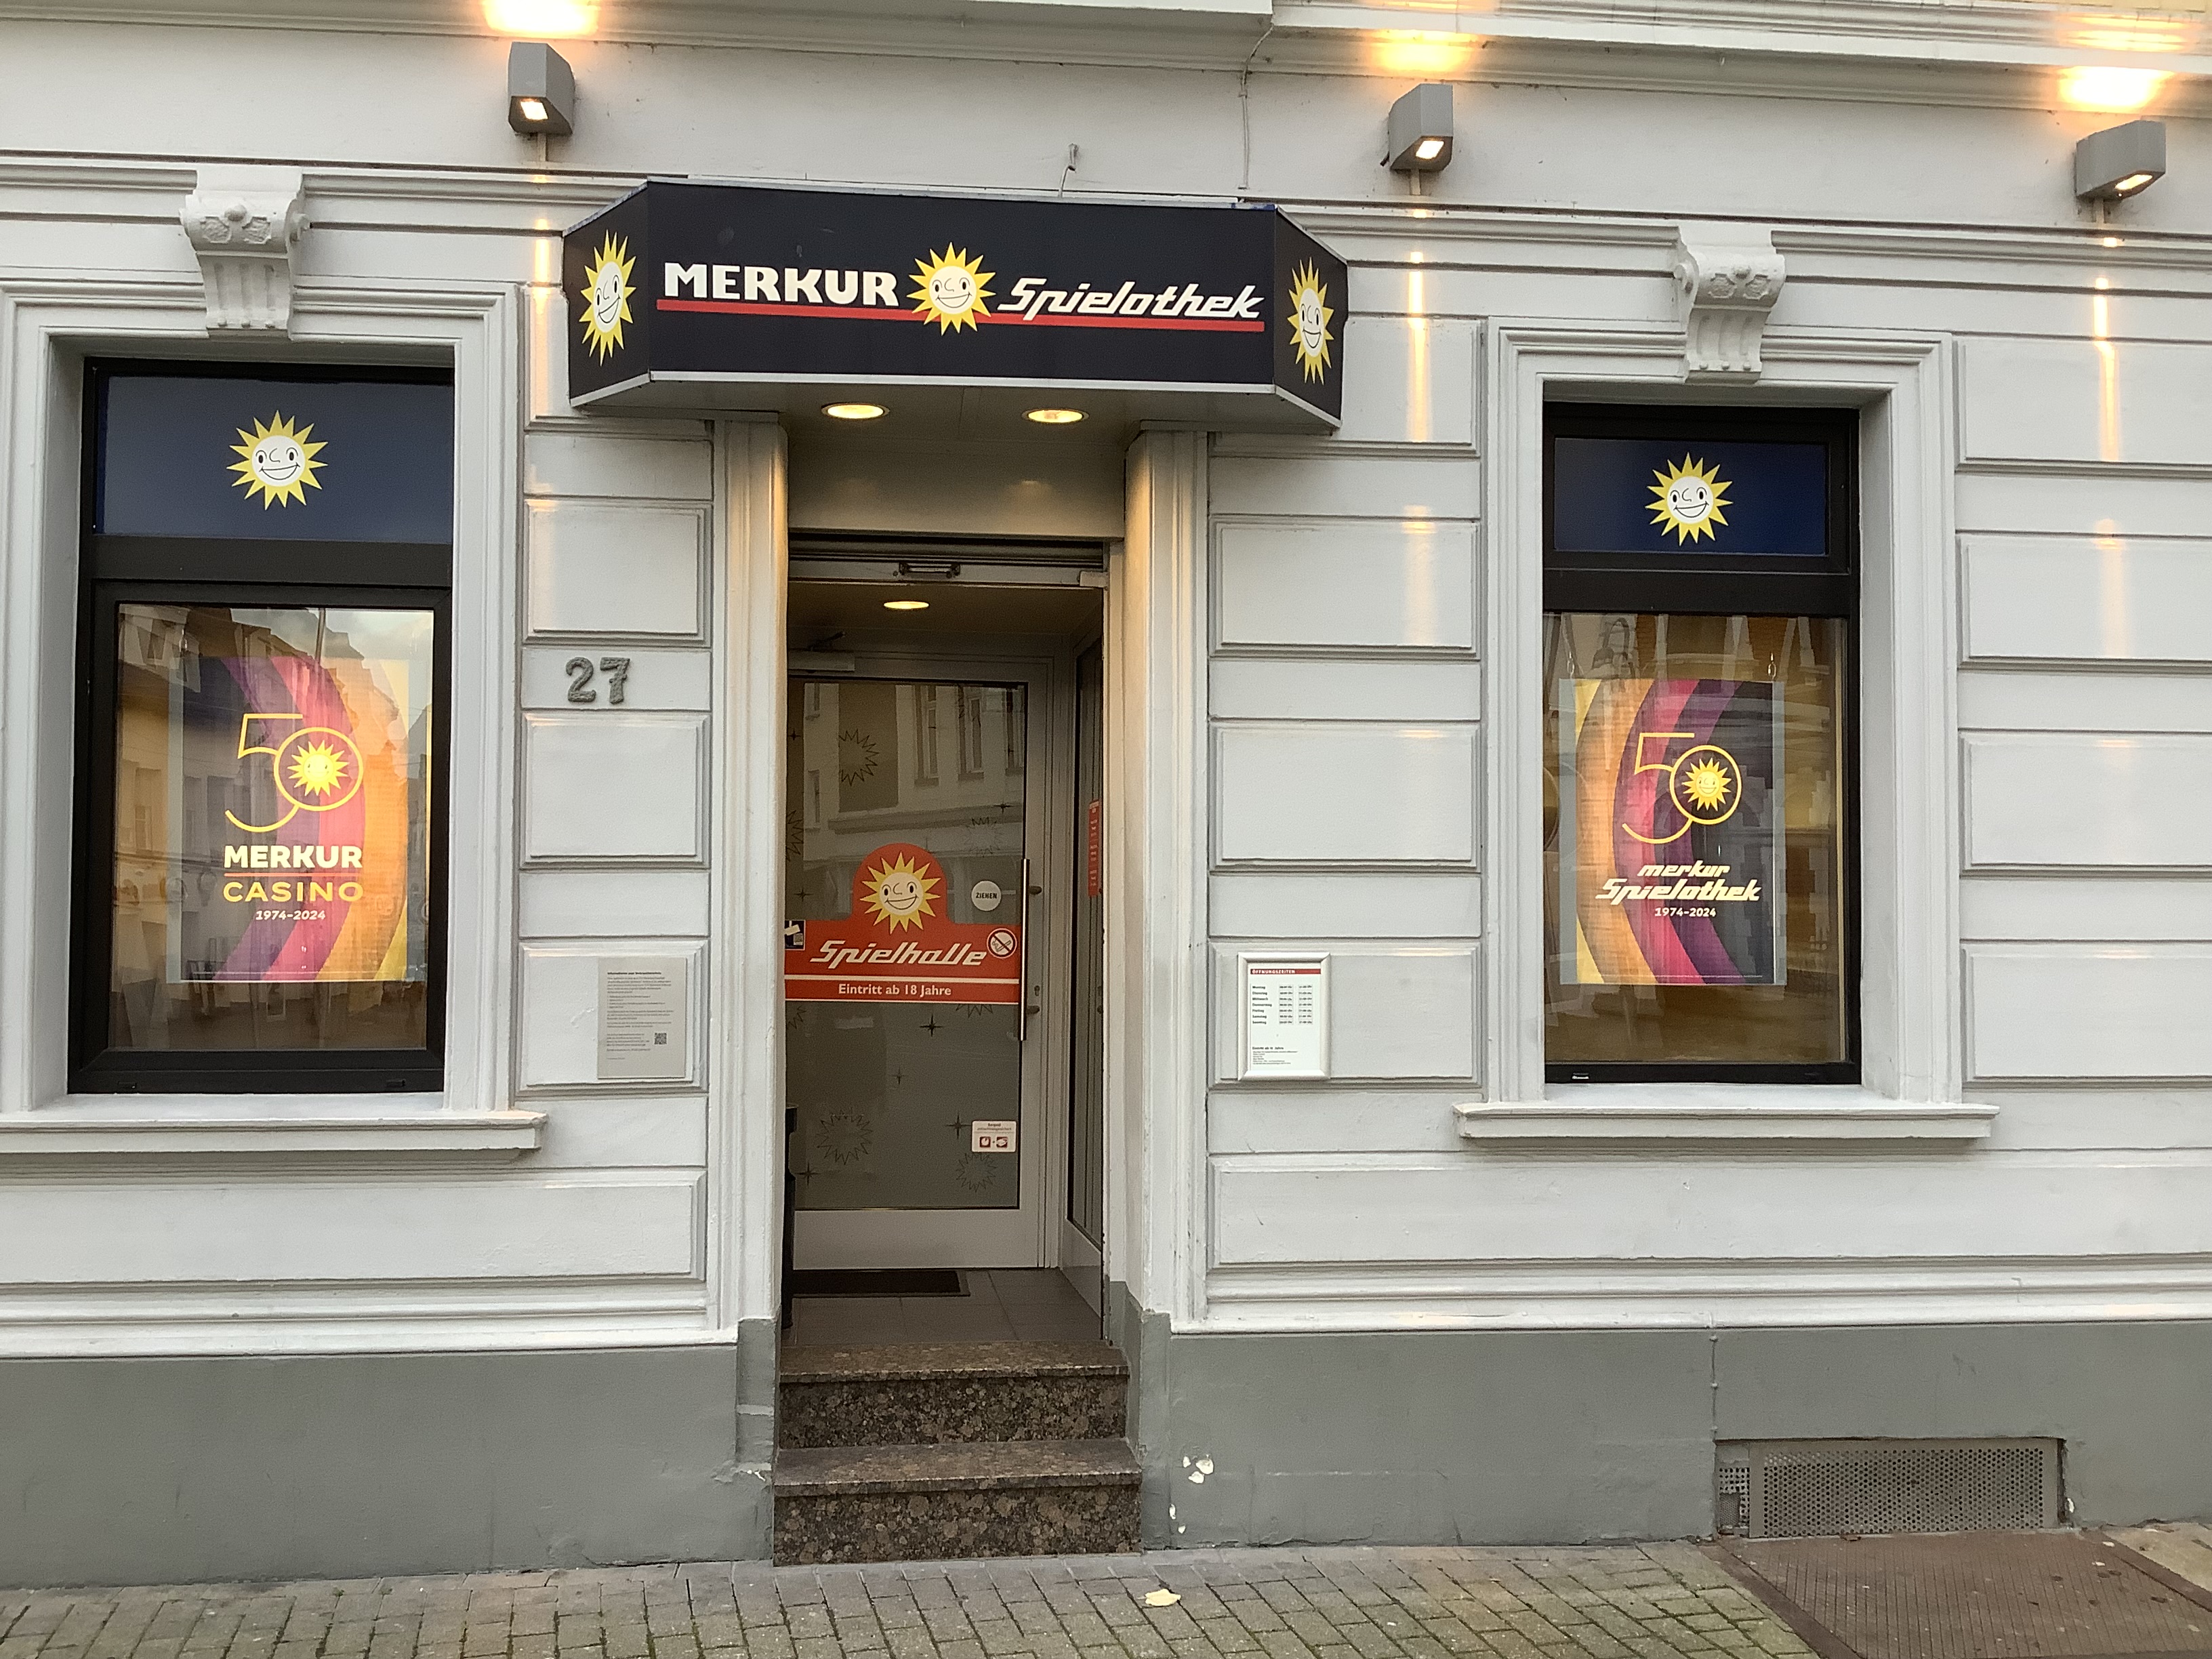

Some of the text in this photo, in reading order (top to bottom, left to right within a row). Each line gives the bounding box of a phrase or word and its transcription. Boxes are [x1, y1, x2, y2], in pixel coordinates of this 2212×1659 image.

[665, 262, 1265, 321] MERKUR Spielothek
[566, 657, 630, 705] 27
[224, 713, 364, 832] 50
[1622, 733, 1742, 844] 50
[224, 846, 363, 868] MERKUR
[1637, 860, 1731, 877] merkur
[223, 882, 364, 902] CASINO
[1595, 878, 1762, 905] Spielothek
[255, 910, 326, 920] 1974-2024
[1654, 907, 1717, 917] 1974-2024
[810, 940, 987, 969] Spielhalle
[838, 983, 952, 998] Eintritt ab 18 Jahre
